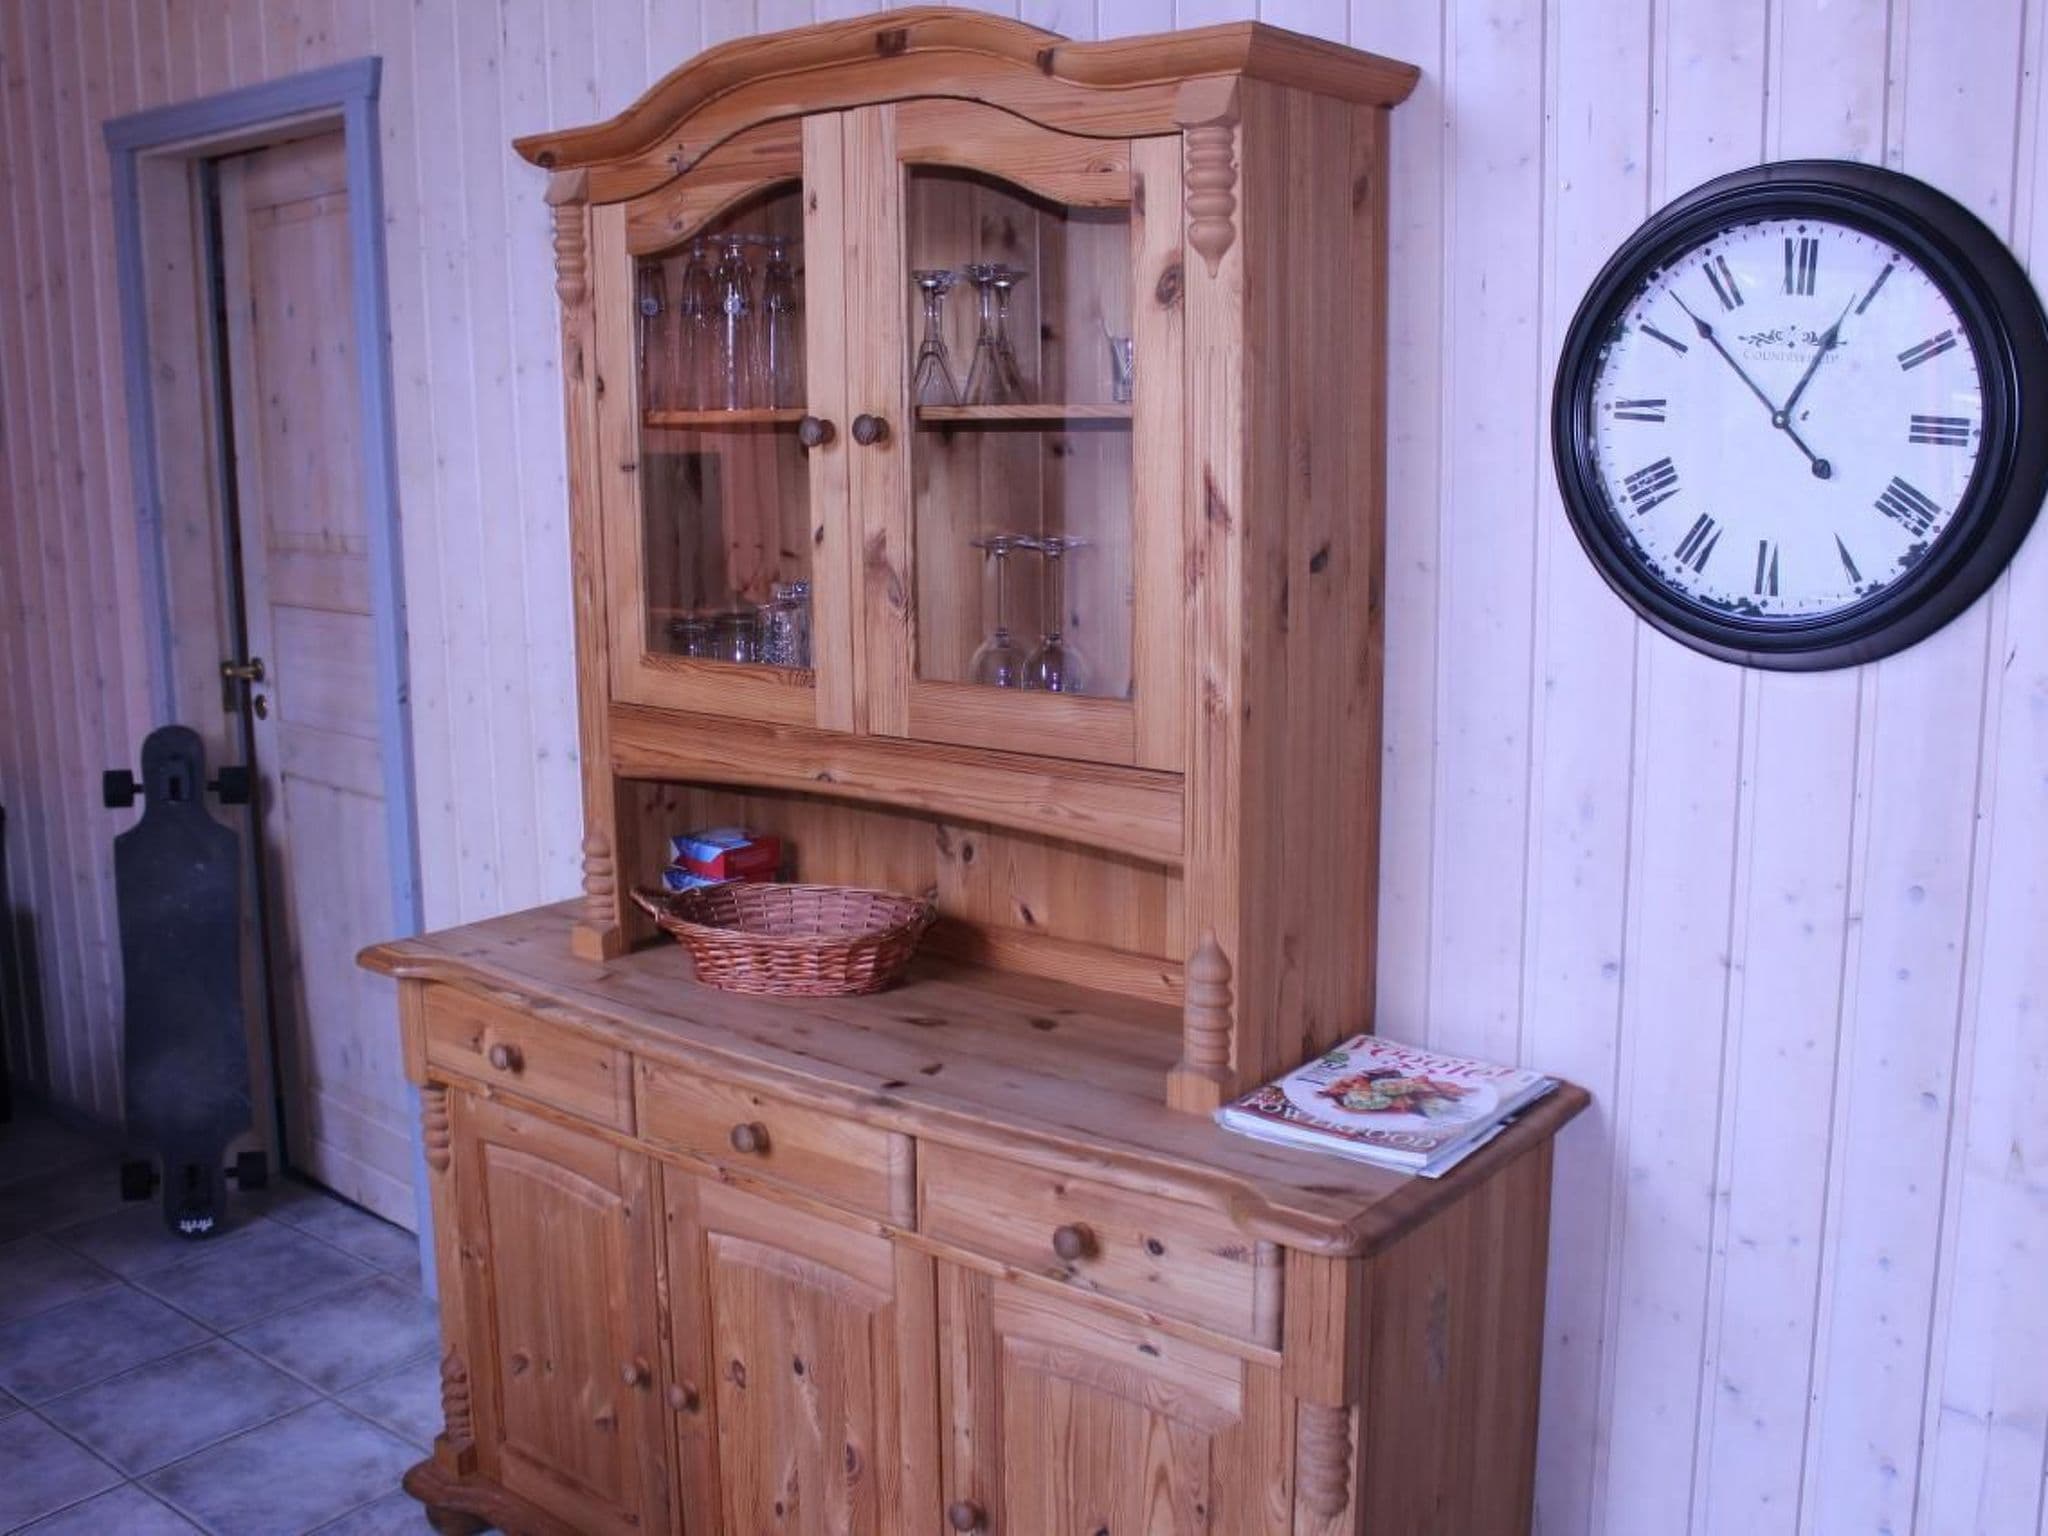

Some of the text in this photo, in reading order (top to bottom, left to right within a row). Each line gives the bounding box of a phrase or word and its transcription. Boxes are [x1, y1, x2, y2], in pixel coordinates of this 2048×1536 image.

[1784, 237, 1819, 296] XII
[1855, 263, 1895, 316] I
[1897, 328, 1957, 371] II
[1908, 414, 1971, 447] III
[1673, 512, 1723, 573] VII
[1754, 538, 1779, 597] VI
